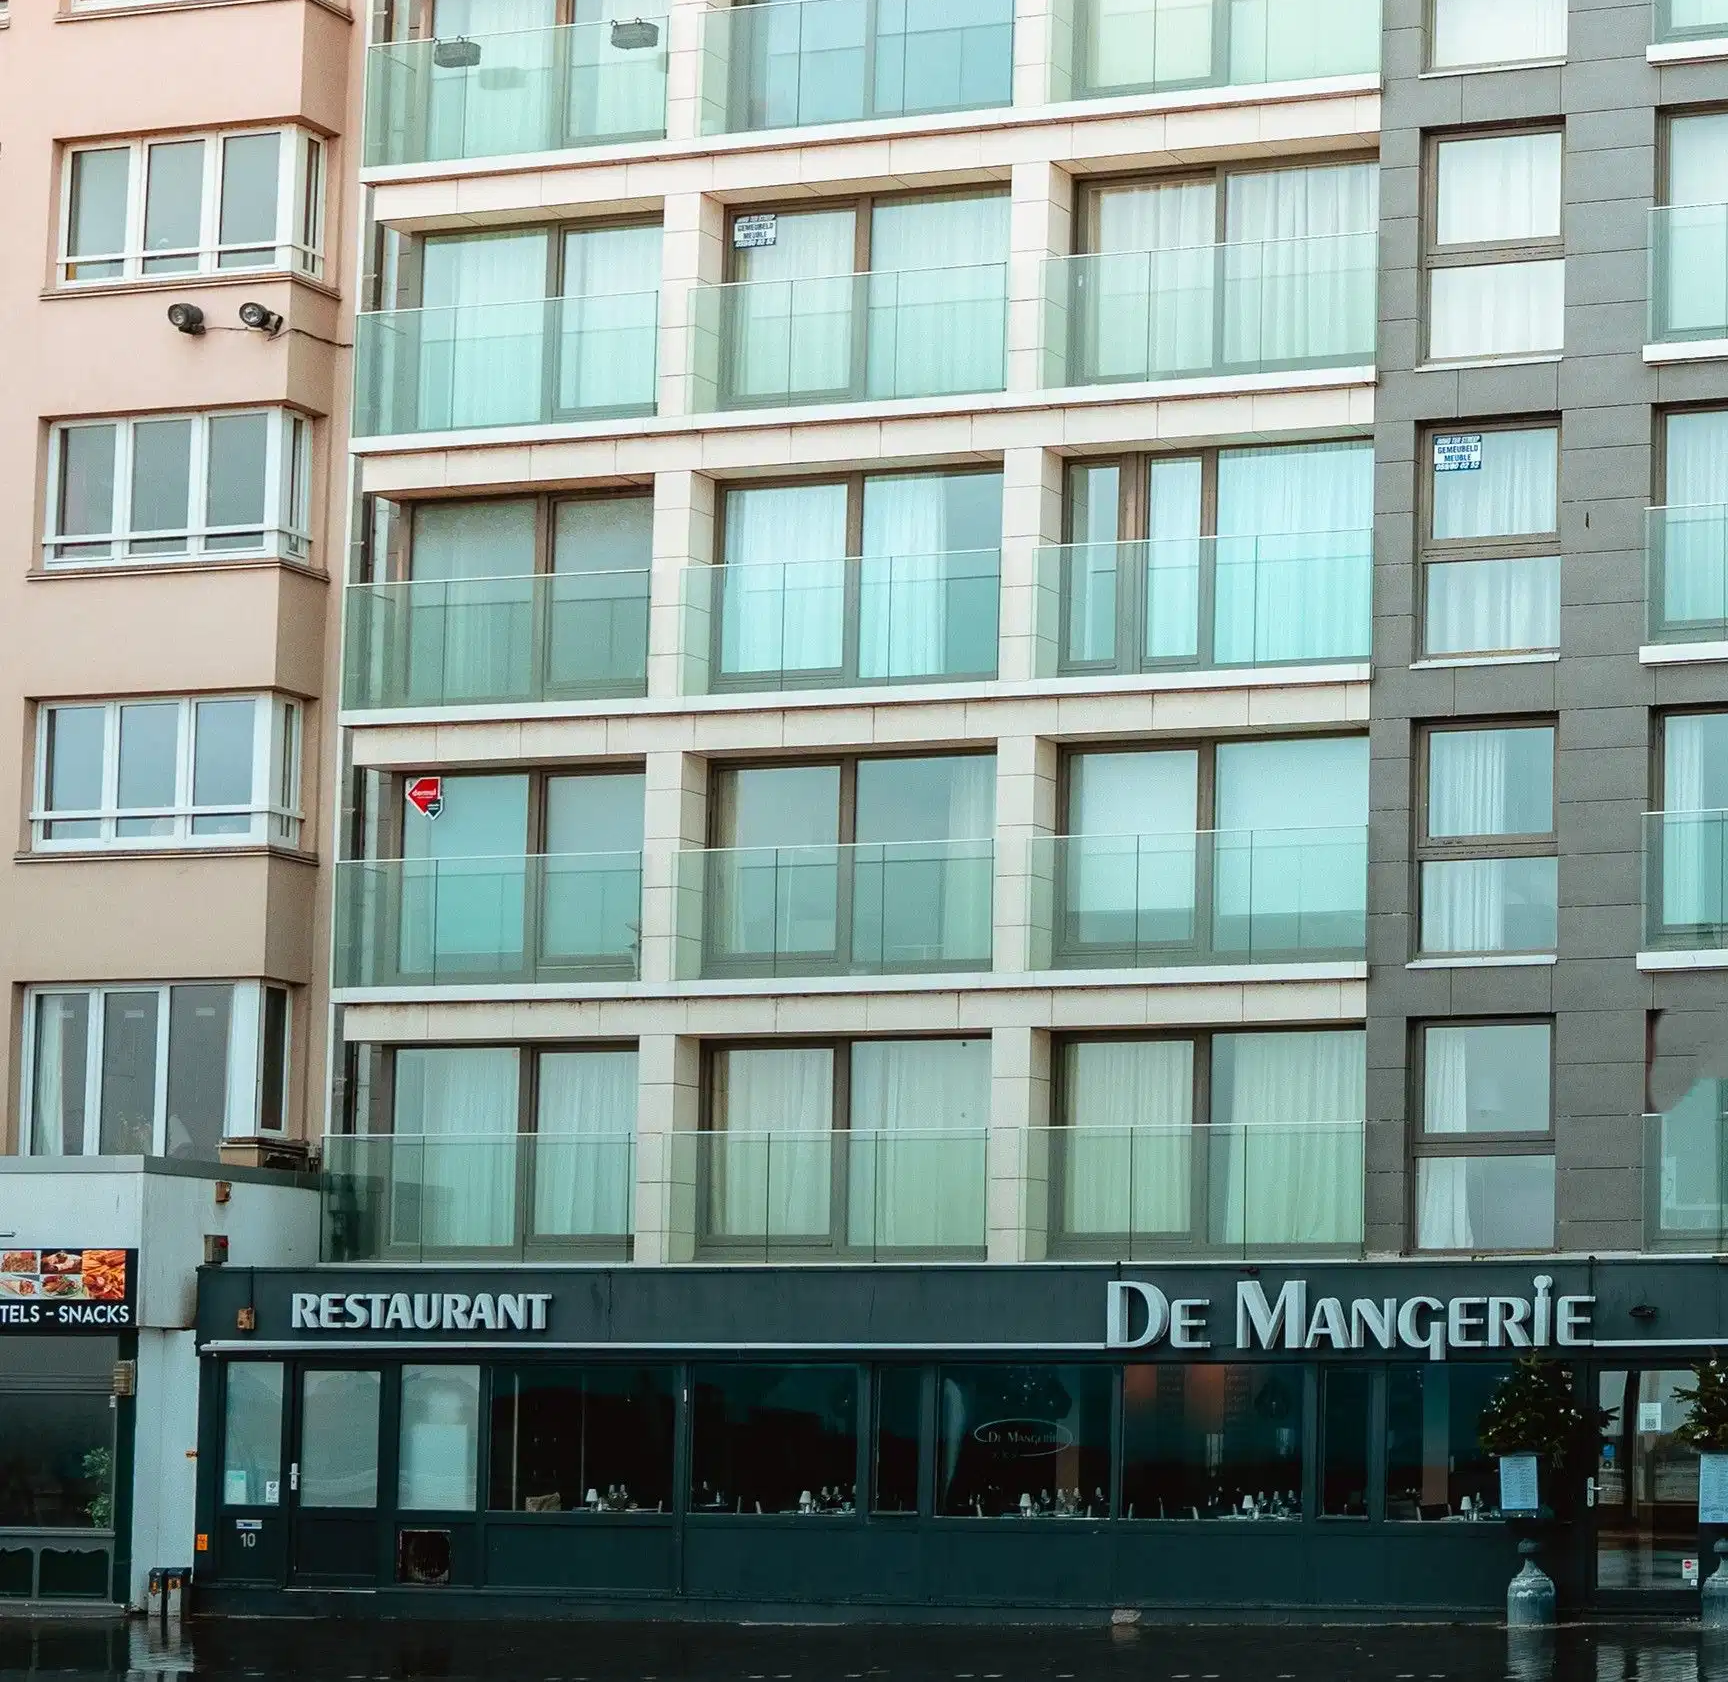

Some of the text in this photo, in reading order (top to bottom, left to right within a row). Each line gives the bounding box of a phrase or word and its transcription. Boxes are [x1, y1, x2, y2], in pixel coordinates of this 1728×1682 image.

[1437, 445, 1479, 454] GEMEUBELD
[0, 1305, 40, 1323] TELS
[58, 1305, 130, 1323] SNACKS
[292, 1293, 552, 1330] RESTAURANT
[241, 1532, 256, 1548] 10
